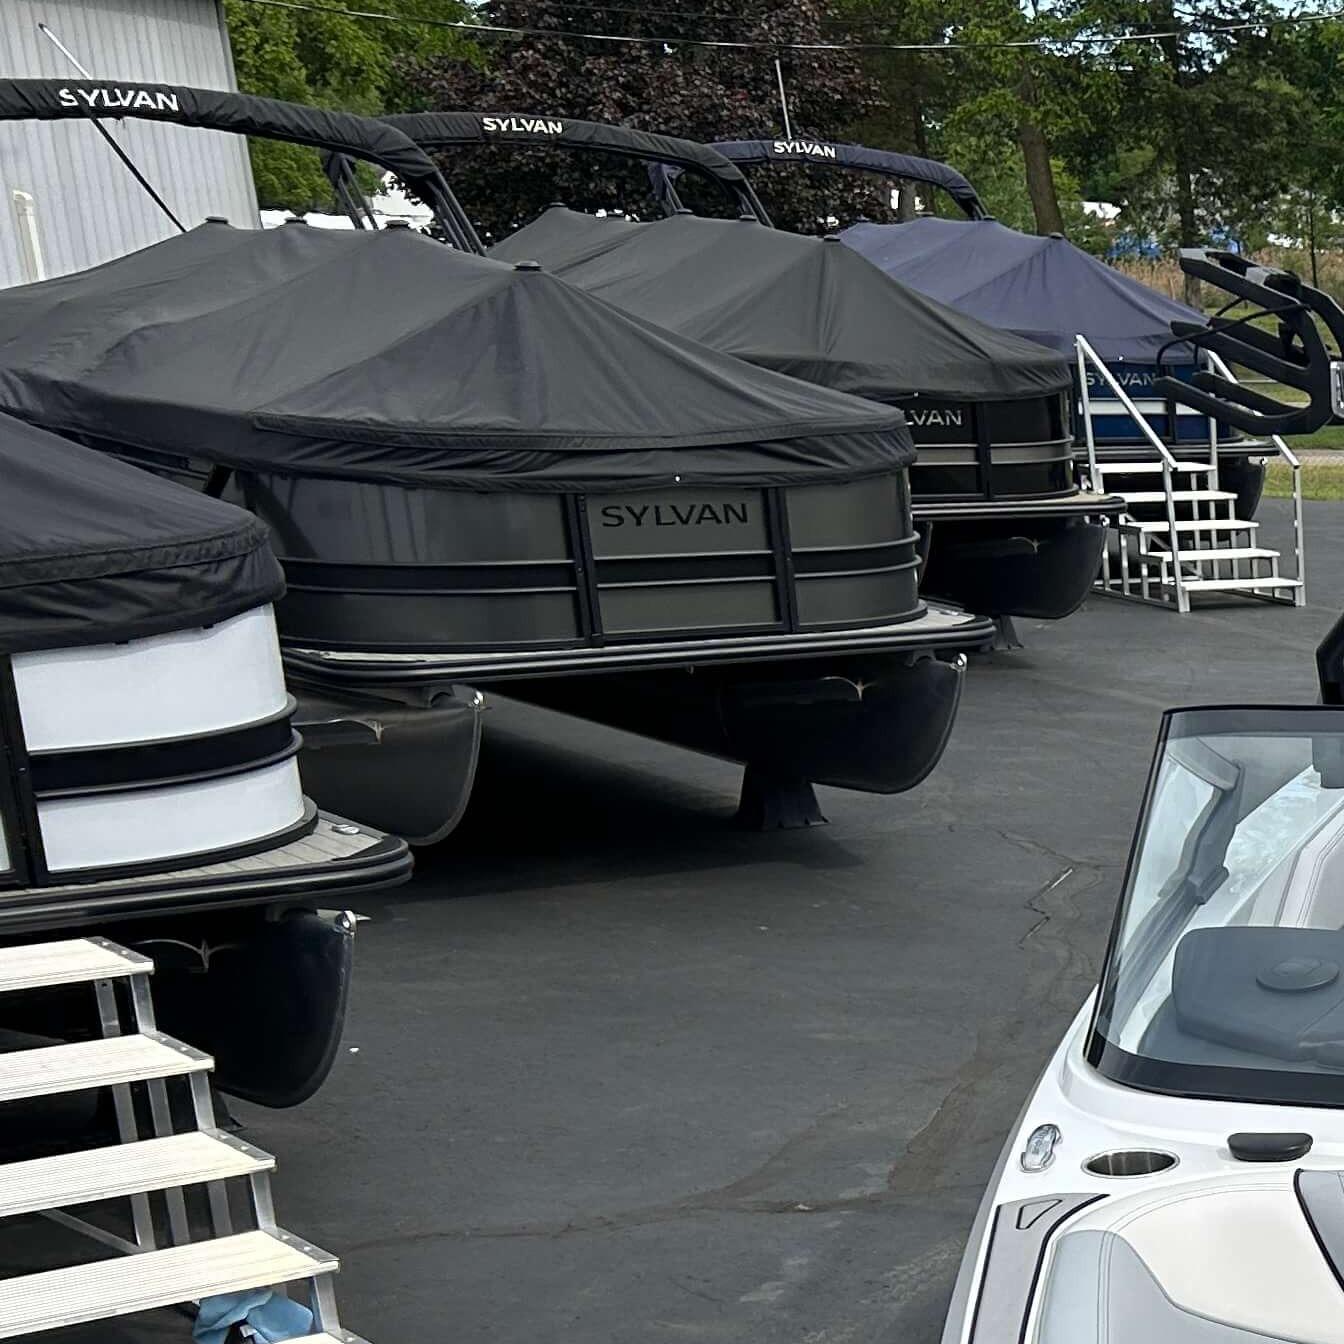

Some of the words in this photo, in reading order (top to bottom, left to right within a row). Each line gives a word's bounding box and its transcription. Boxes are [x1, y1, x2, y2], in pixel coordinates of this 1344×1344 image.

[59, 88, 179, 111] SYLVAN
[483, 117, 562, 133] SYLVAN
[774, 141, 835, 159] SYLVAN
[601, 503, 748, 527] SYLVAN
